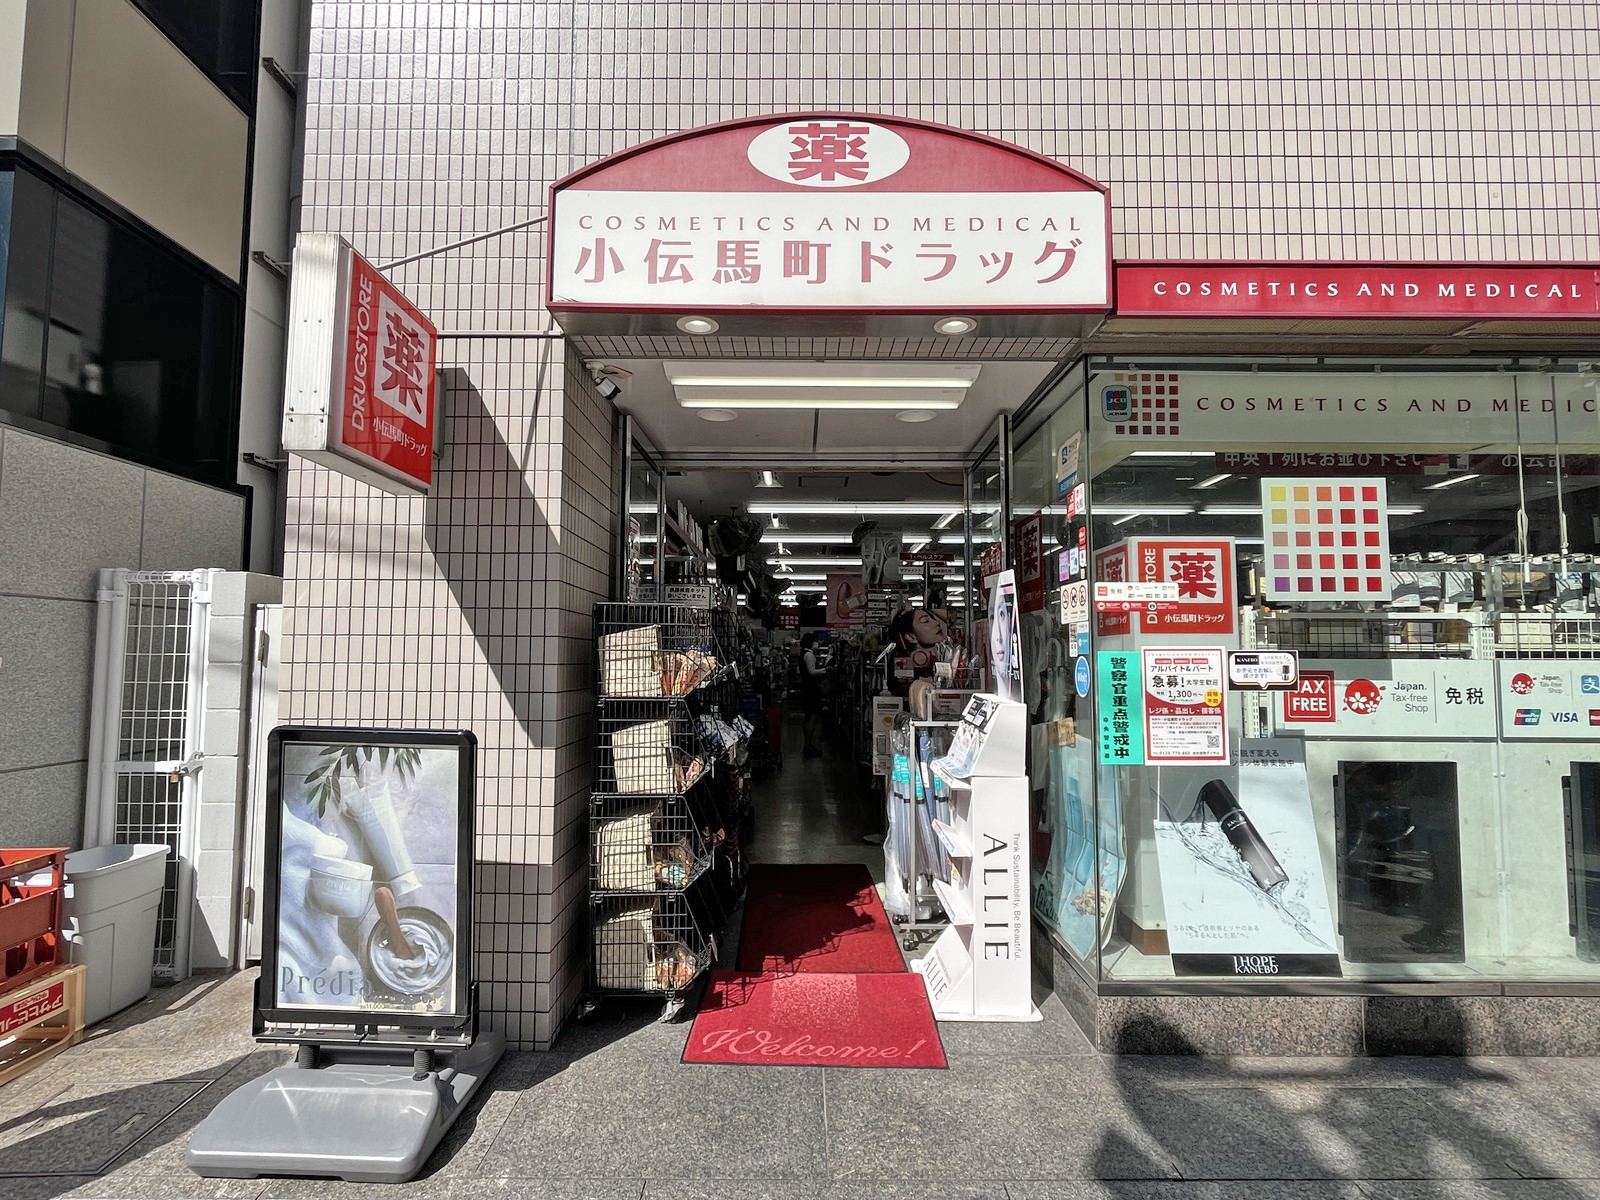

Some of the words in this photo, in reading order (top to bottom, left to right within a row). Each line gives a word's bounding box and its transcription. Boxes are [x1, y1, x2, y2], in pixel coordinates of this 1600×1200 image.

[788, 122, 870, 182] 薬
[578, 215, 797, 231] COSMETICS
[816, 216, 890, 231] AND
[912, 216, 1083, 231] MEDICAL
[573, 237, 1084, 284] 小伝馬町ドラッグ
[1153, 281, 1339, 297] COSMETICS
[1357, 283, 1420, 298] AND
[1438, 284, 1582, 299] MEDICAL
[351, 273, 373, 432] DRUGSTORE
[380, 310, 425, 415] 薬
[1197, 396, 1389, 412] COSMETICS
[1406, 398, 1472, 412] AND
[372, 415, 428, 457] 小伝馬町ドラッグ
[1168, 552, 1217, 599] 薬
[1164, 613, 1225, 623] 小伝馬町ドラッグ
[1393, 682, 1427, 692] Japan.
[1445, 687, 1484, 705] 免税
[1111, 657, 1130, 758] 警察官重点警戒中
[1293, 697, 1327, 711] FREE
[1391, 693, 1428, 702] Tax-free
[1405, 703, 1428, 714] Shop
[1550, 712, 1579, 722] VISA
[1012, 832, 1021, 852] Think
[983, 832, 1009, 960] ALLIE
[1012, 911, 1021, 921] Be
[1012, 923, 1022, 960] Beautiful.
[1234, 965, 1279, 973] KANEBO
[1239, 955, 1276, 966] HOPE
[280, 965, 373, 998] Prédia
[923, 957, 948, 1001] ALLIE
[0, 994, 63, 1033] アサヒビール
[702, 1029, 927, 1058] Welcome!
